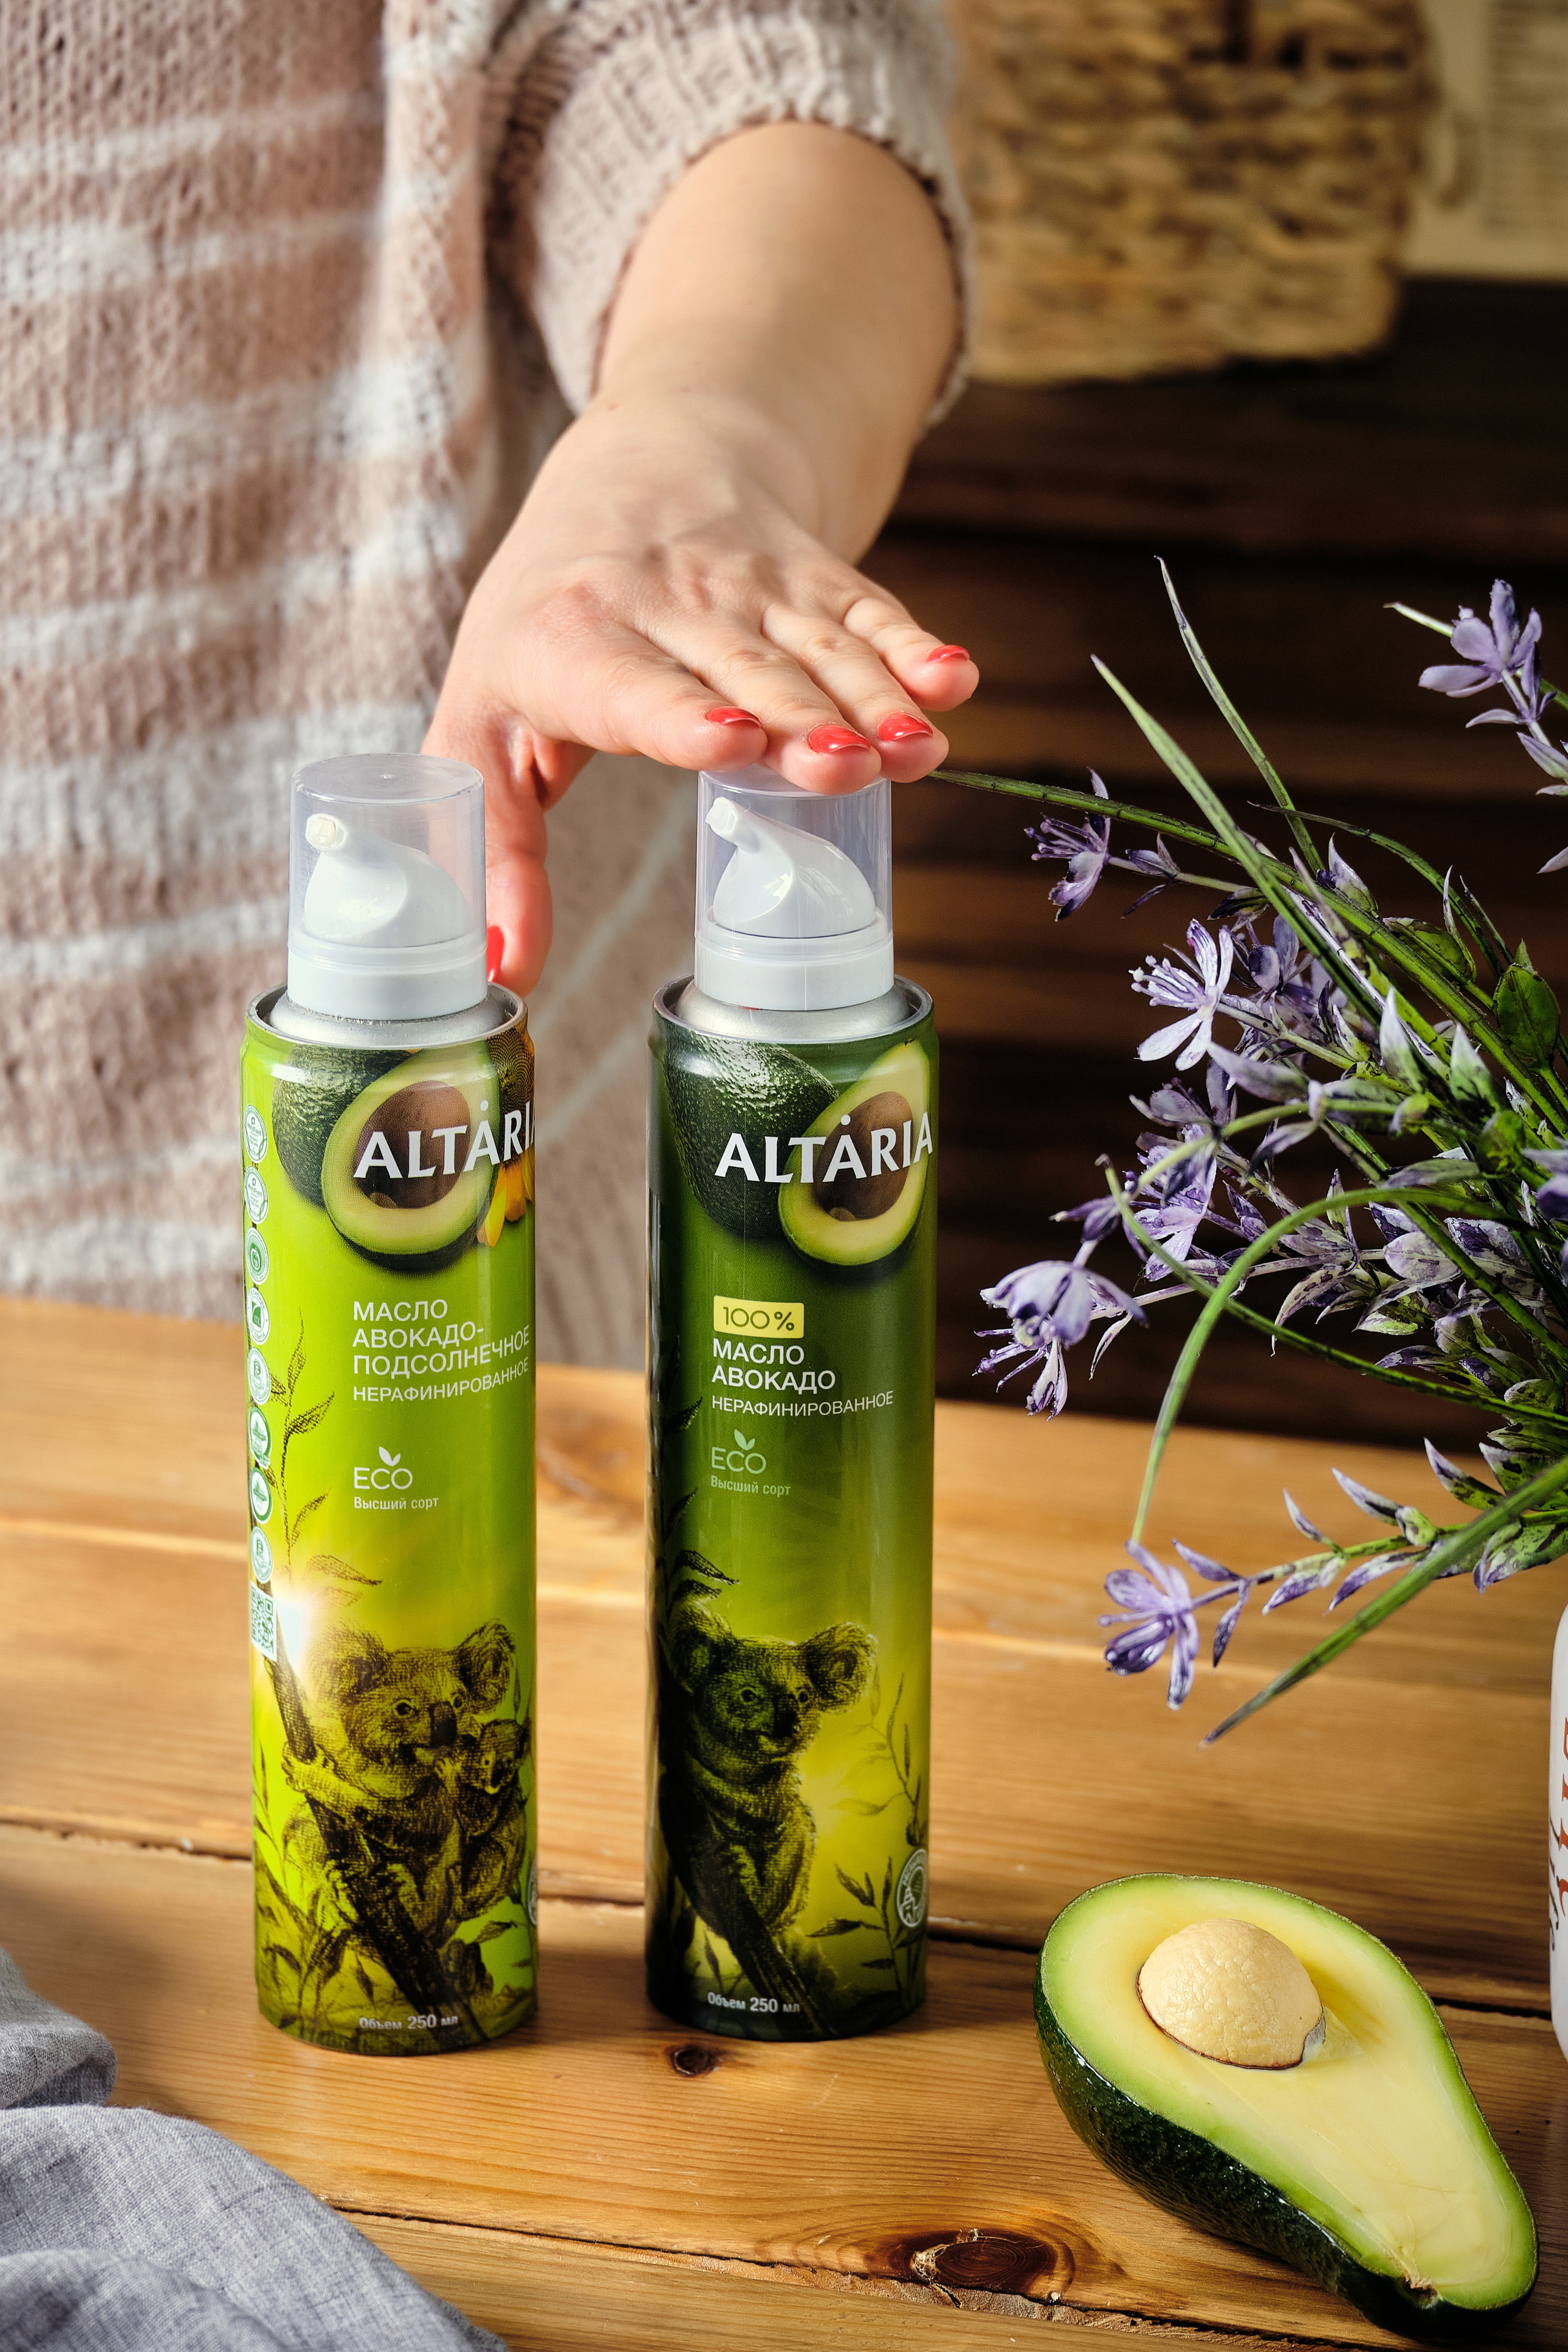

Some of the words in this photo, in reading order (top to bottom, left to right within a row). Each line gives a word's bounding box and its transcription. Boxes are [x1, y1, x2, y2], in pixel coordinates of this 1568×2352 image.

[353, 1298, 448, 1322] МАСЛО
[723, 1306, 795, 1332] 100%
[352, 1321, 484, 1349] АВОКАДО-
[353, 1324, 530, 1379] ПОДСОЛНЕЧНОЕ
[713, 1338, 805, 1365] МАСЛО
[353, 1357, 529, 1401] НЕРАФИНИРОВАННОЕ
[712, 1365, 836, 1395] АВОКАДО
[712, 1390, 894, 1417] НЕРАФИНИРОВАННОЕ
[711, 1446, 766, 1474] ECO
[353, 1466, 413, 1490] ECO
[710, 1475, 759, 1494] Высший
[763, 1482, 791, 1498] сорт
[353, 1496, 407, 1510] Высший
[411, 1497, 439, 1510] сорт
[707, 1992, 746, 2010] Объем
[750, 1997, 778, 2013] 250
[783, 2003, 800, 2013] мл
[359, 2016, 402, 2030] Объем
[407, 2014, 437, 2029] 250
[440, 2016, 459, 2026] мл
